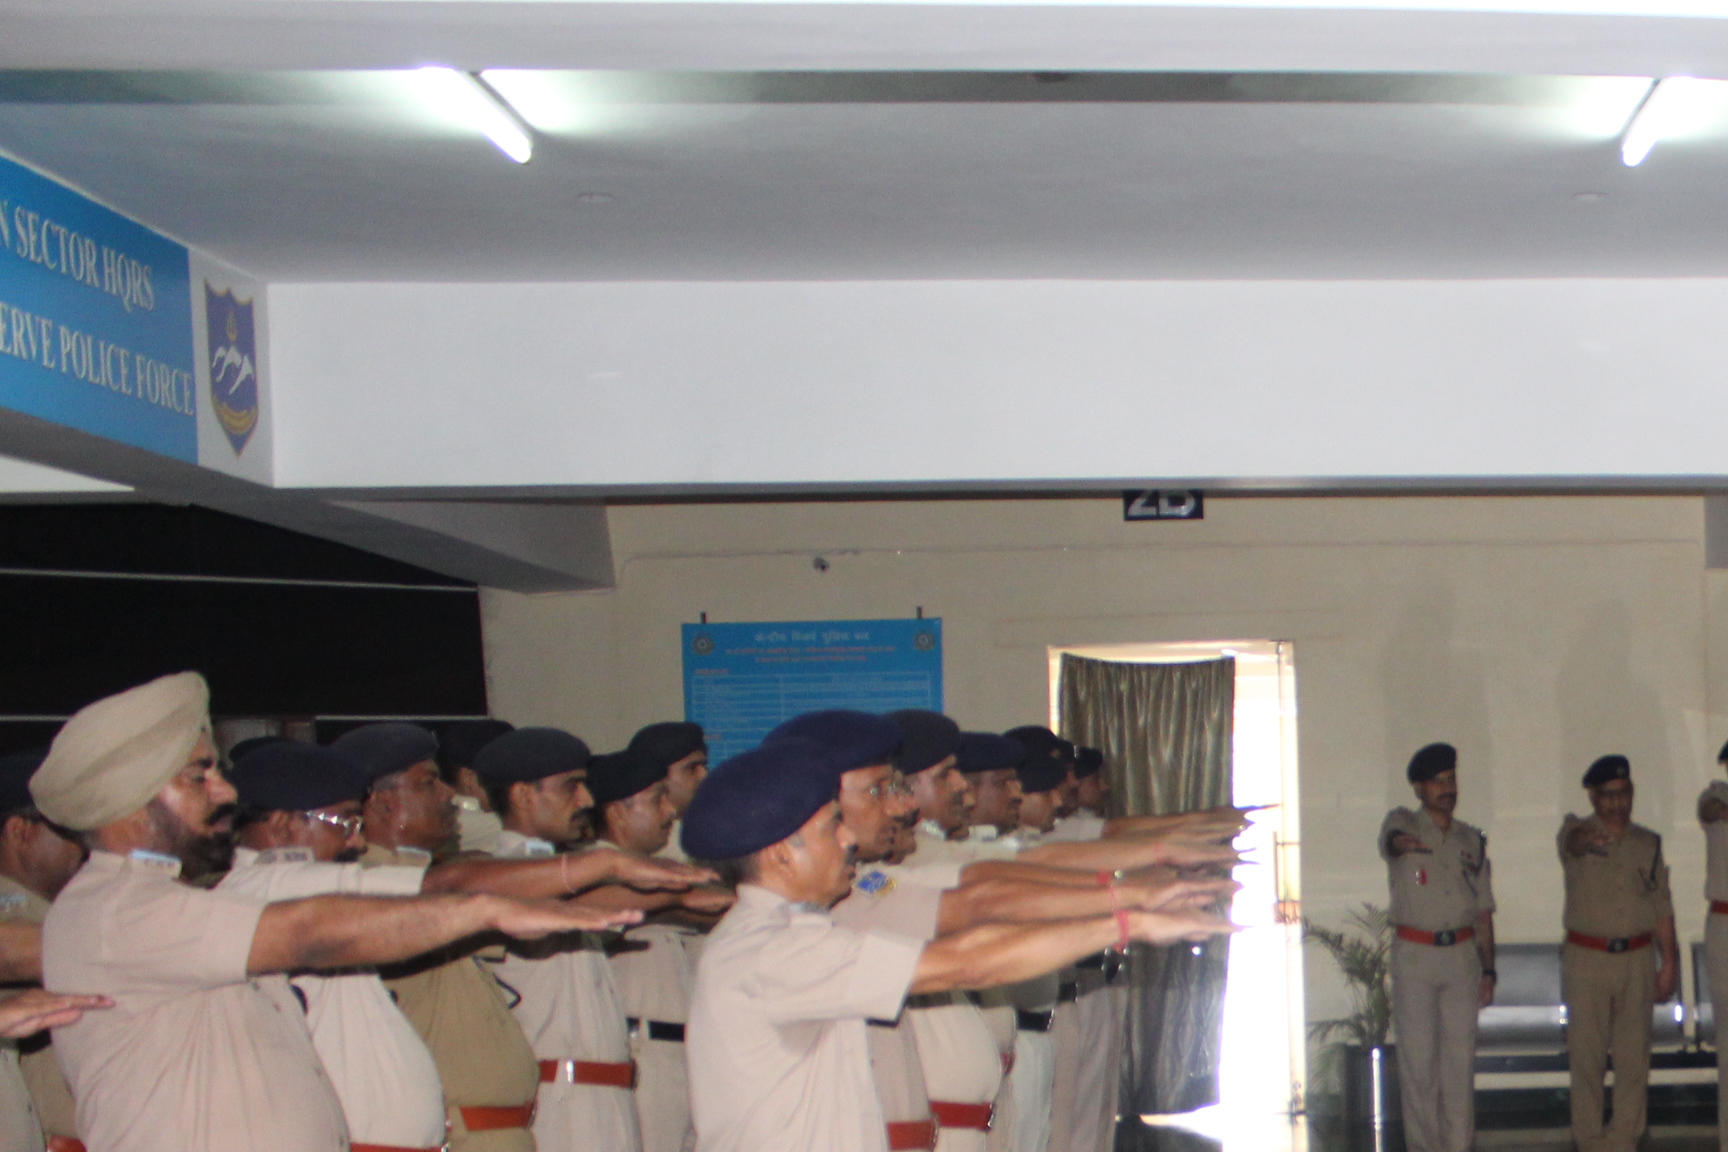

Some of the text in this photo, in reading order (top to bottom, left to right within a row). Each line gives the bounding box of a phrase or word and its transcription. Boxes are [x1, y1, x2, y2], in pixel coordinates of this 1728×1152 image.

[15, 205, 99, 288] SECTOR
[102, 245, 154, 314] HQRS
[60, 325, 131, 395] POLICE
[136, 354, 194, 416] FORCE
